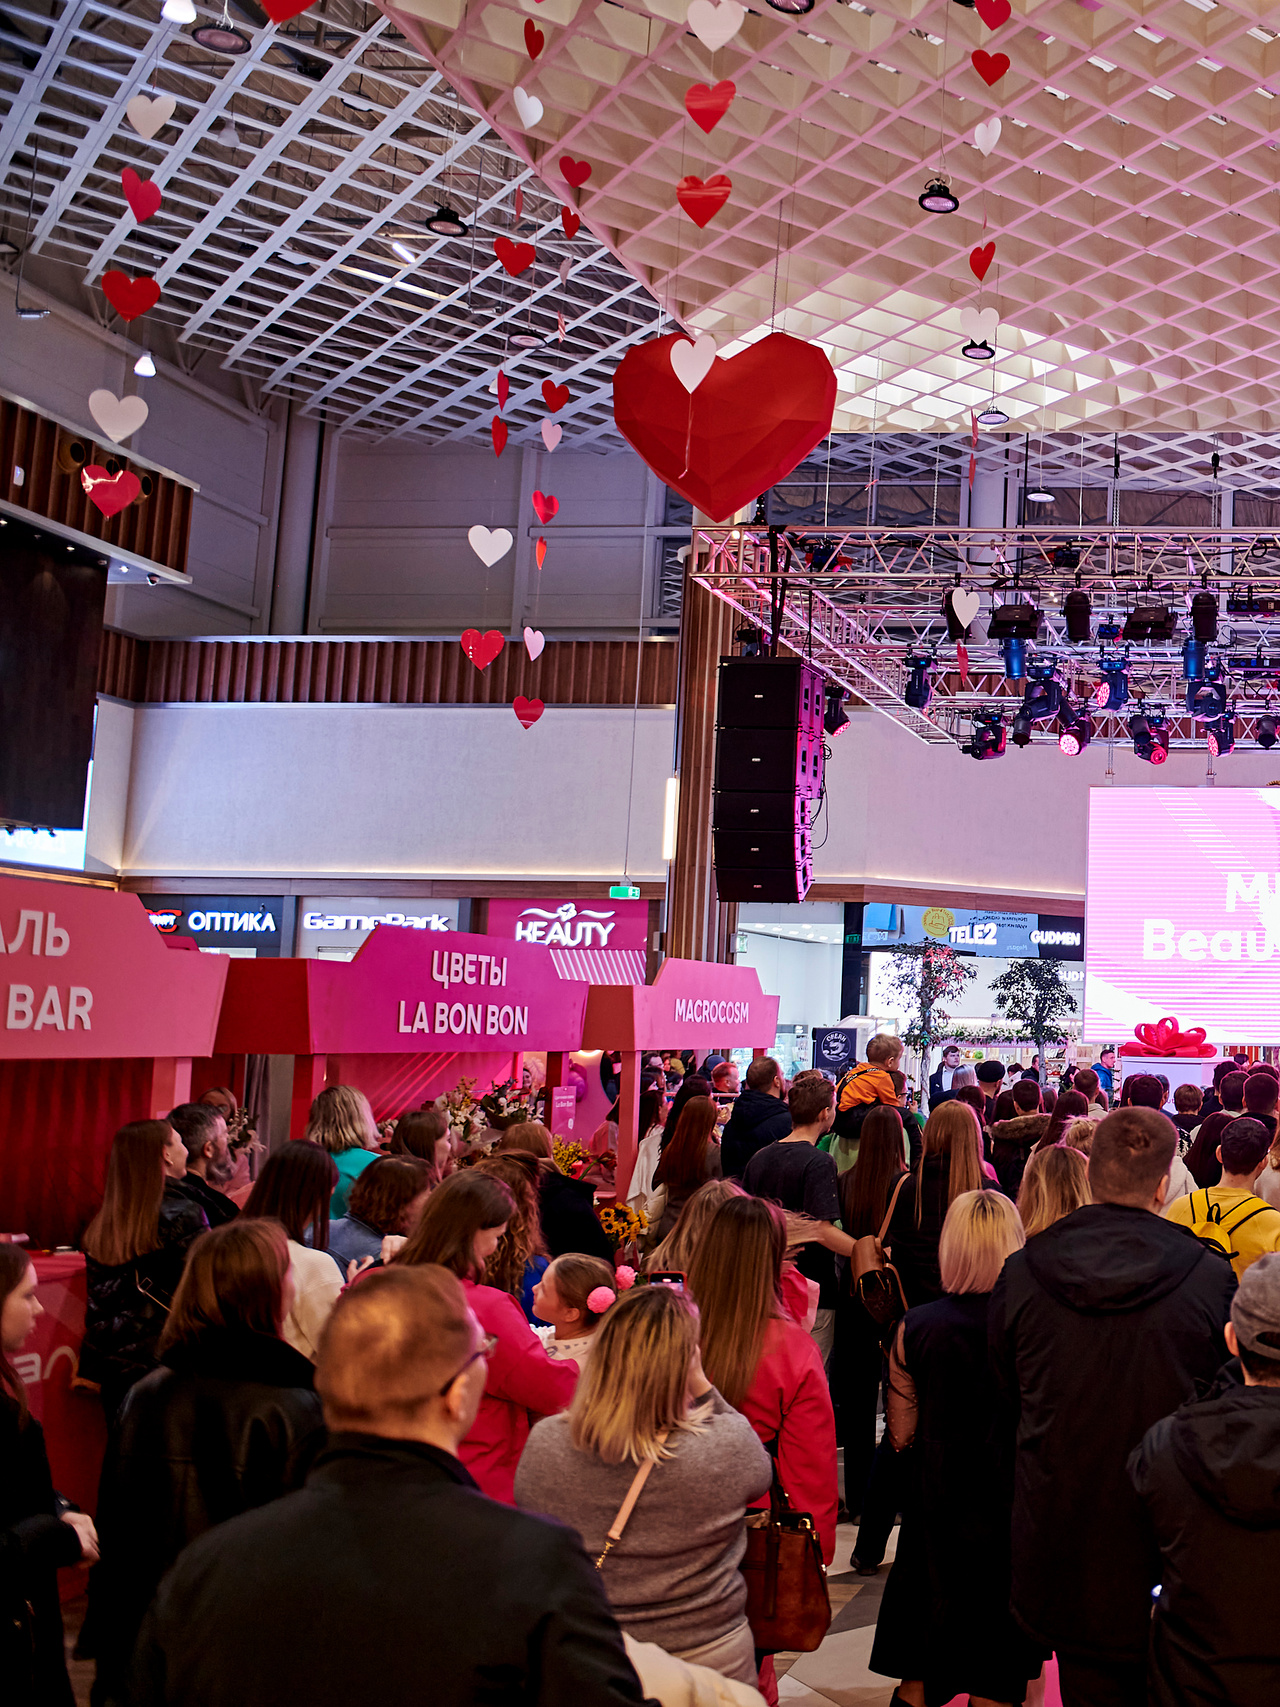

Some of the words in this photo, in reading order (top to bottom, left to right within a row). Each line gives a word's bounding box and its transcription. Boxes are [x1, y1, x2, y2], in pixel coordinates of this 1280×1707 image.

[0, 909, 71, 957] ЛЬ
[188, 911, 275, 932] ОПТИКА
[948, 923, 998, 946] TELE2
[1030, 930, 1081, 946] GUDMEN
[431, 950, 508, 989] ЦВЕТЫ
[6, 984, 94, 1031] BAR
[398, 1000, 430, 1034] LA
[434, 1002, 482, 1035] BON
[485, 1004, 529, 1036] BON
[674, 998, 750, 1024] MACROCOSM
